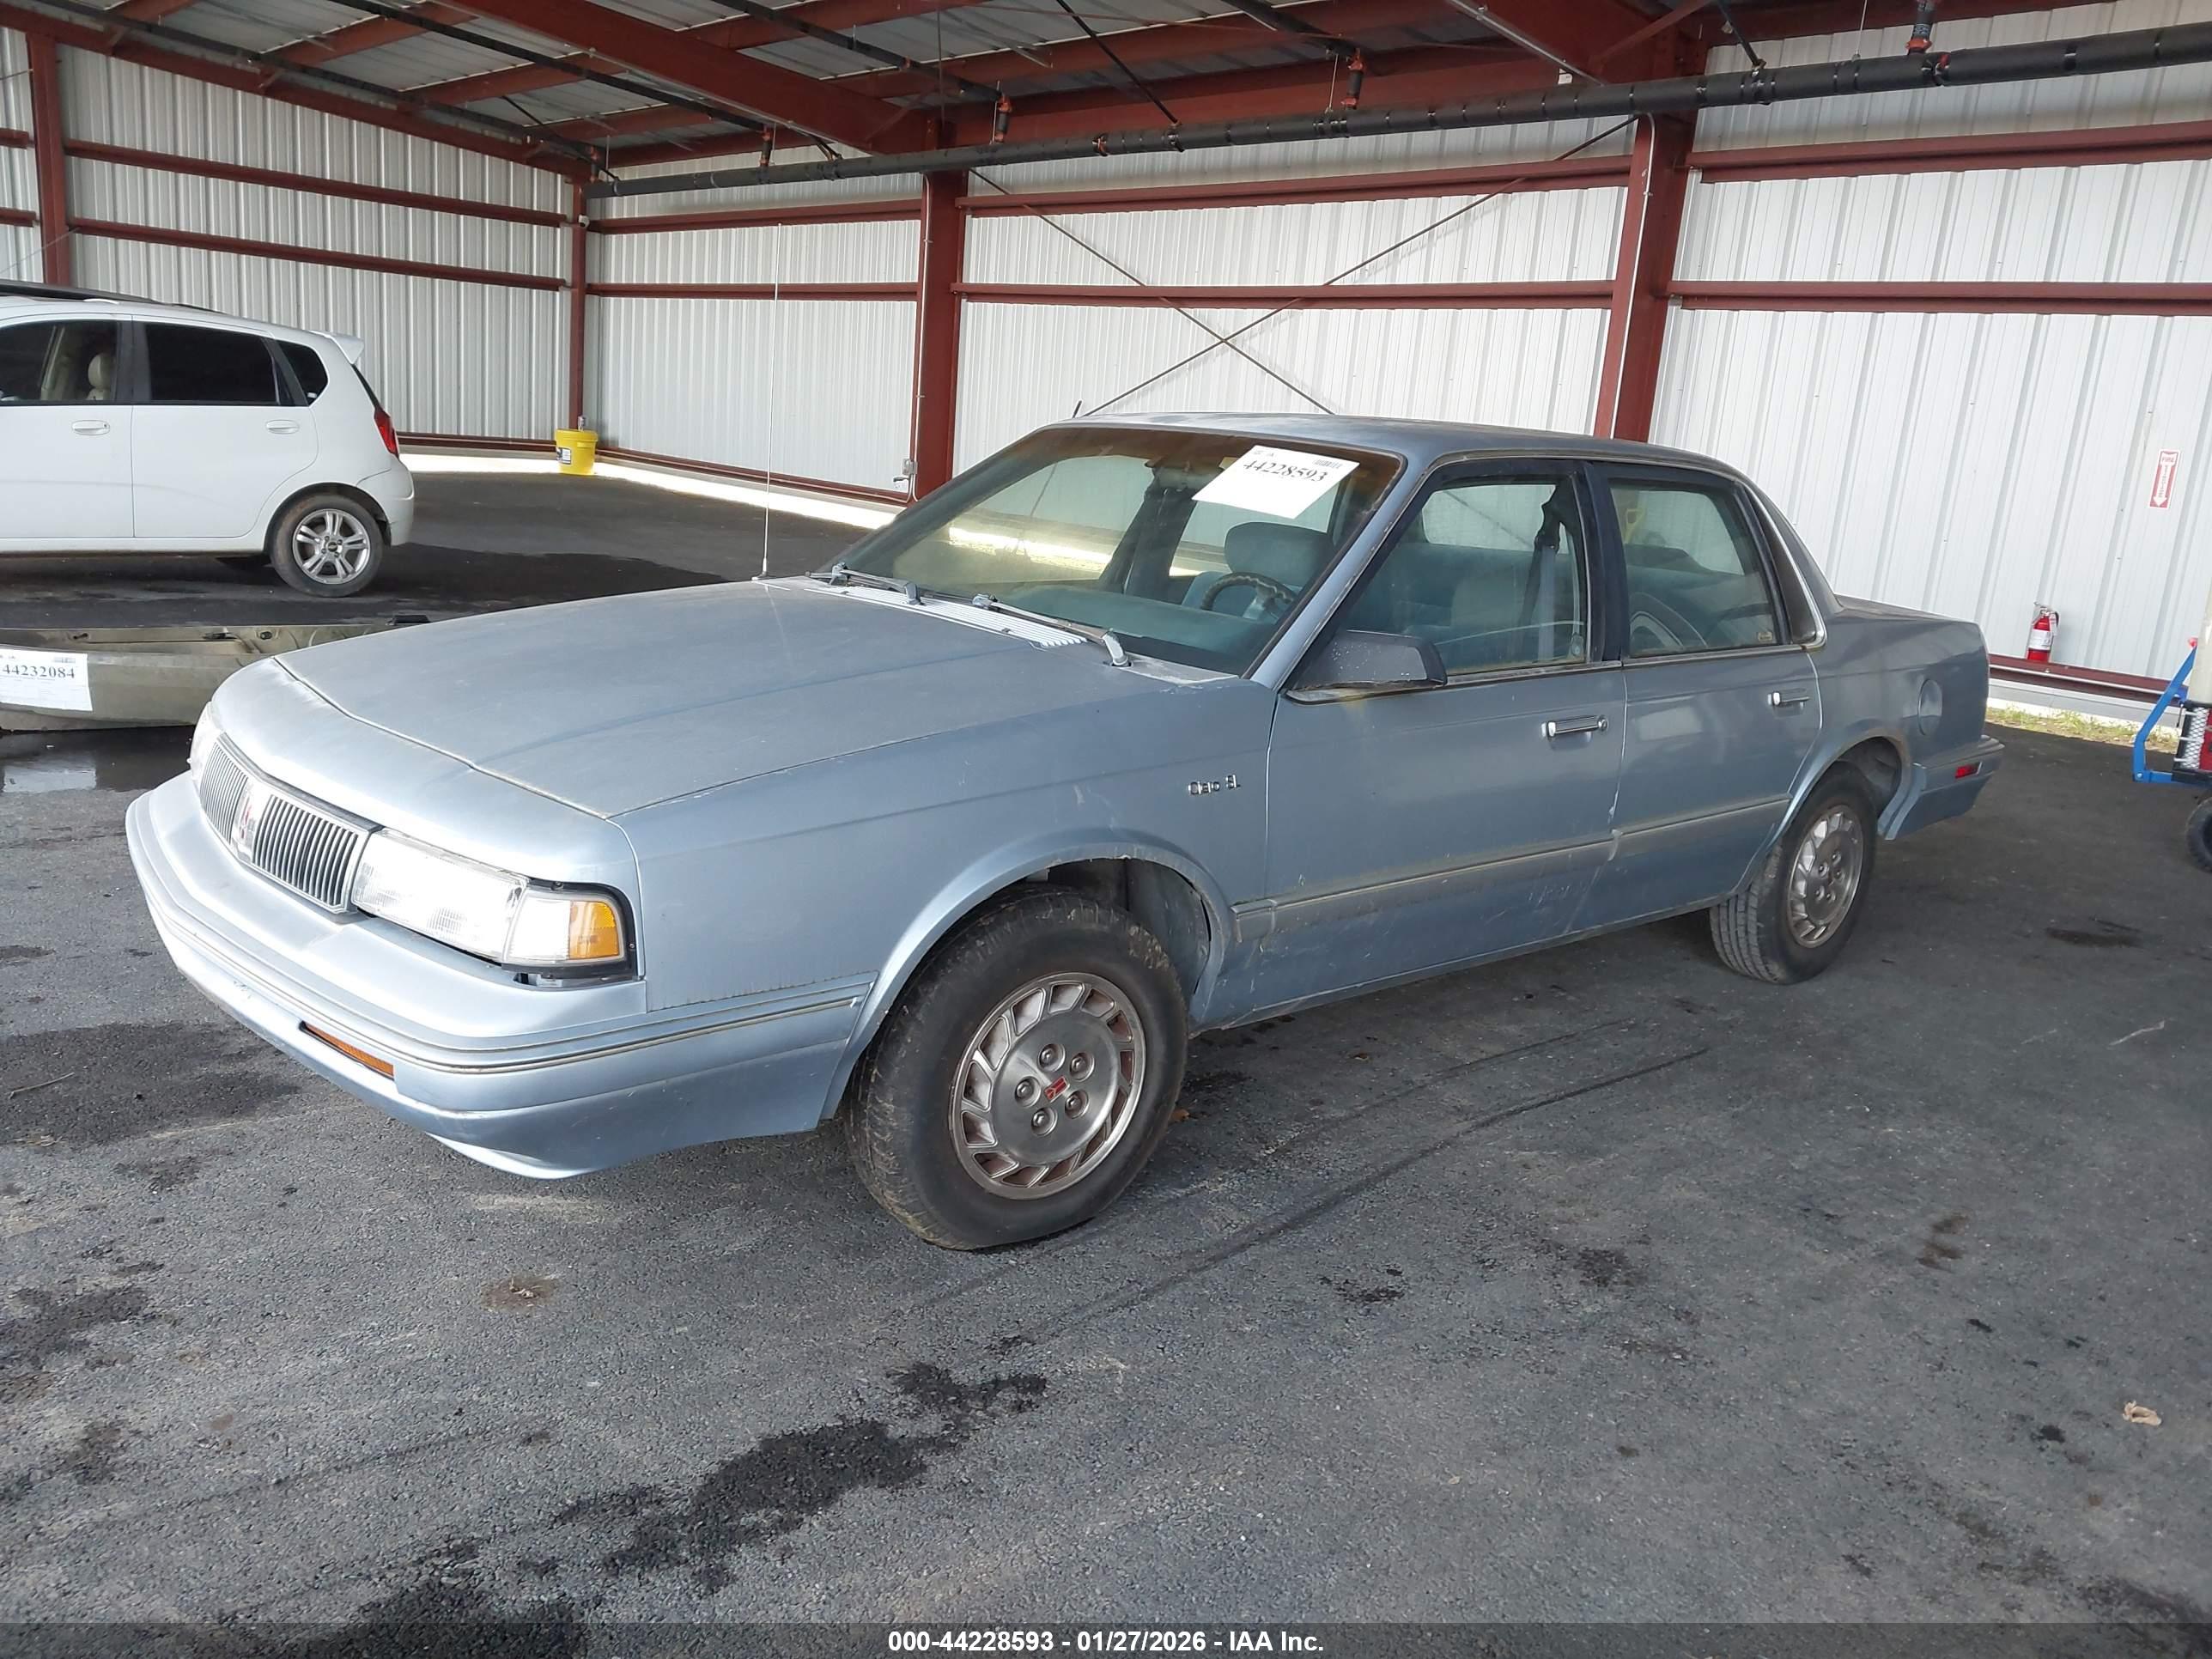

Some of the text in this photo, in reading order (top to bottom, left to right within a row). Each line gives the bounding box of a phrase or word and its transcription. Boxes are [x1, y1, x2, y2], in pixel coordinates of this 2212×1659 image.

[1243, 459, 1328, 482] 44228593
[3, 664, 75, 678] 44232084
[1225, 775, 1241, 789] SL
